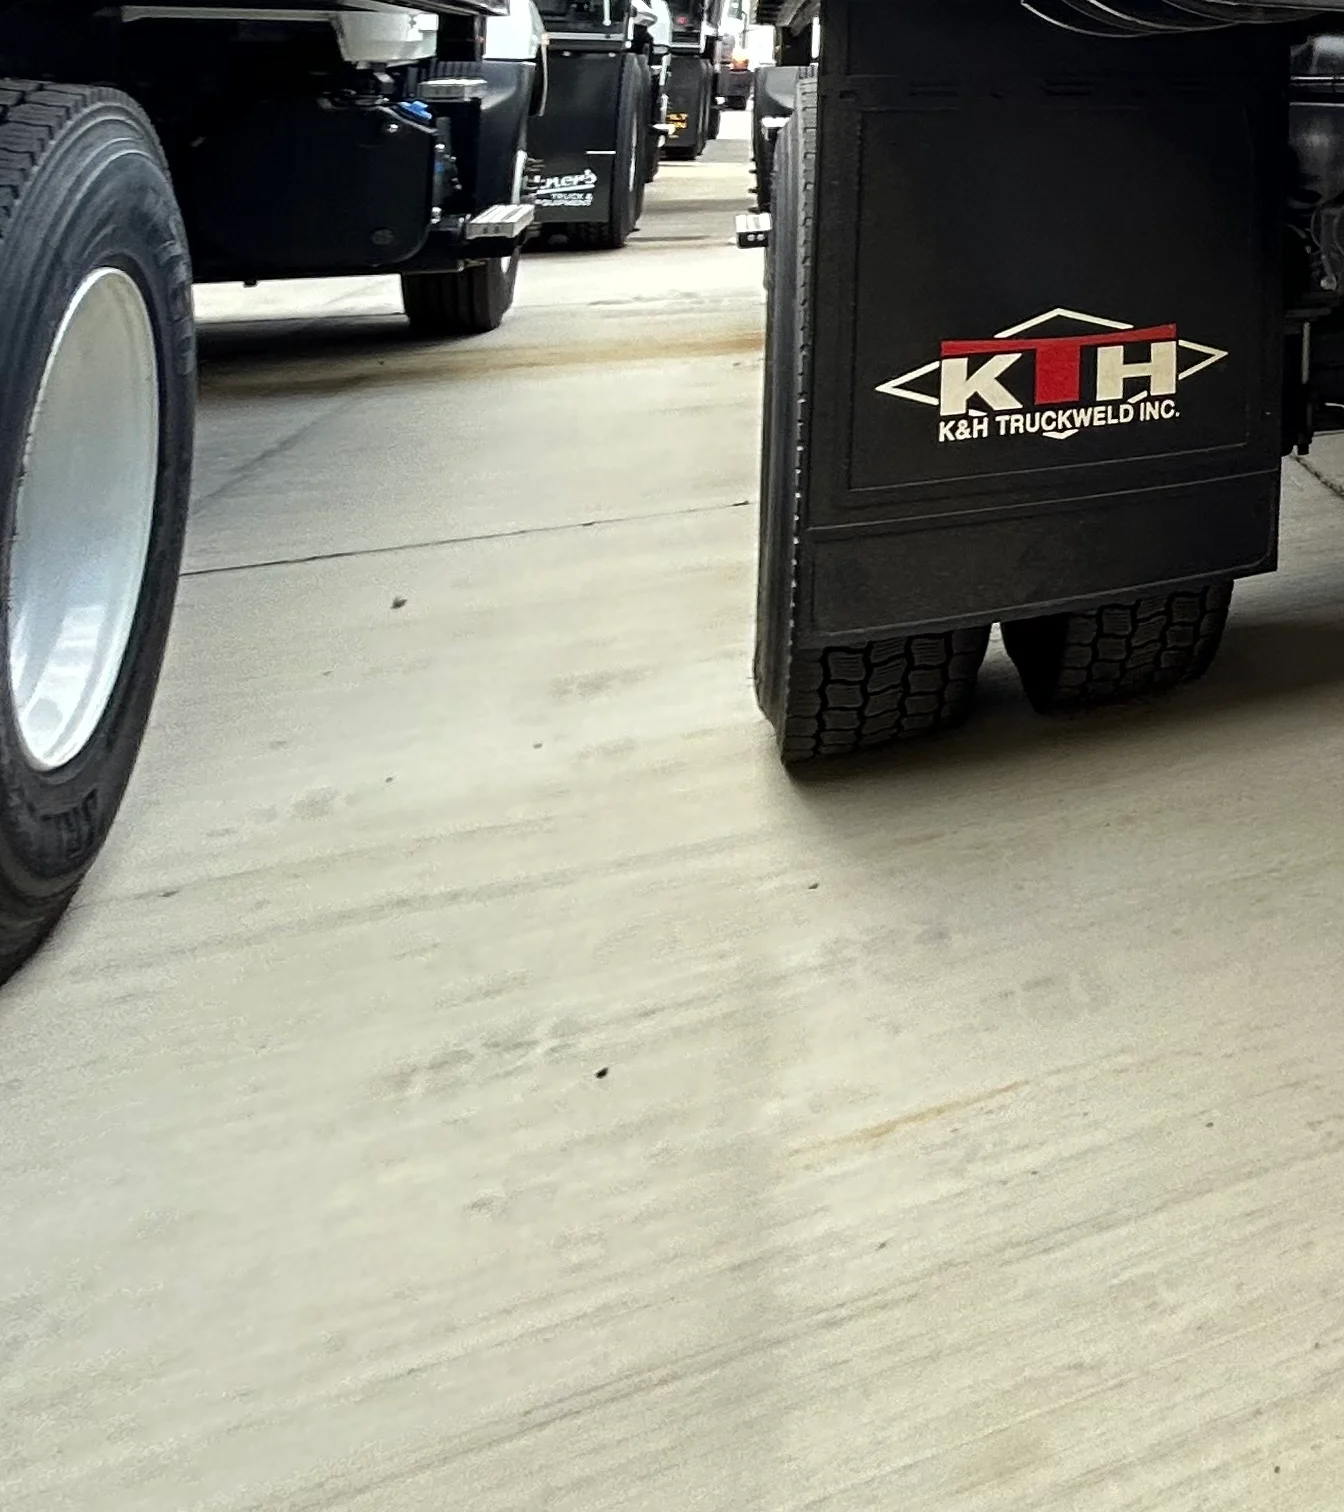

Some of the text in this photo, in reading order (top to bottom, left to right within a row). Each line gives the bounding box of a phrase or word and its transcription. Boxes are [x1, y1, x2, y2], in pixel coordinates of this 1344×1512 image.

[940, 323, 1177, 416] KTH
[938, 398, 1180, 442] K&H TRUCKWELD INC.
